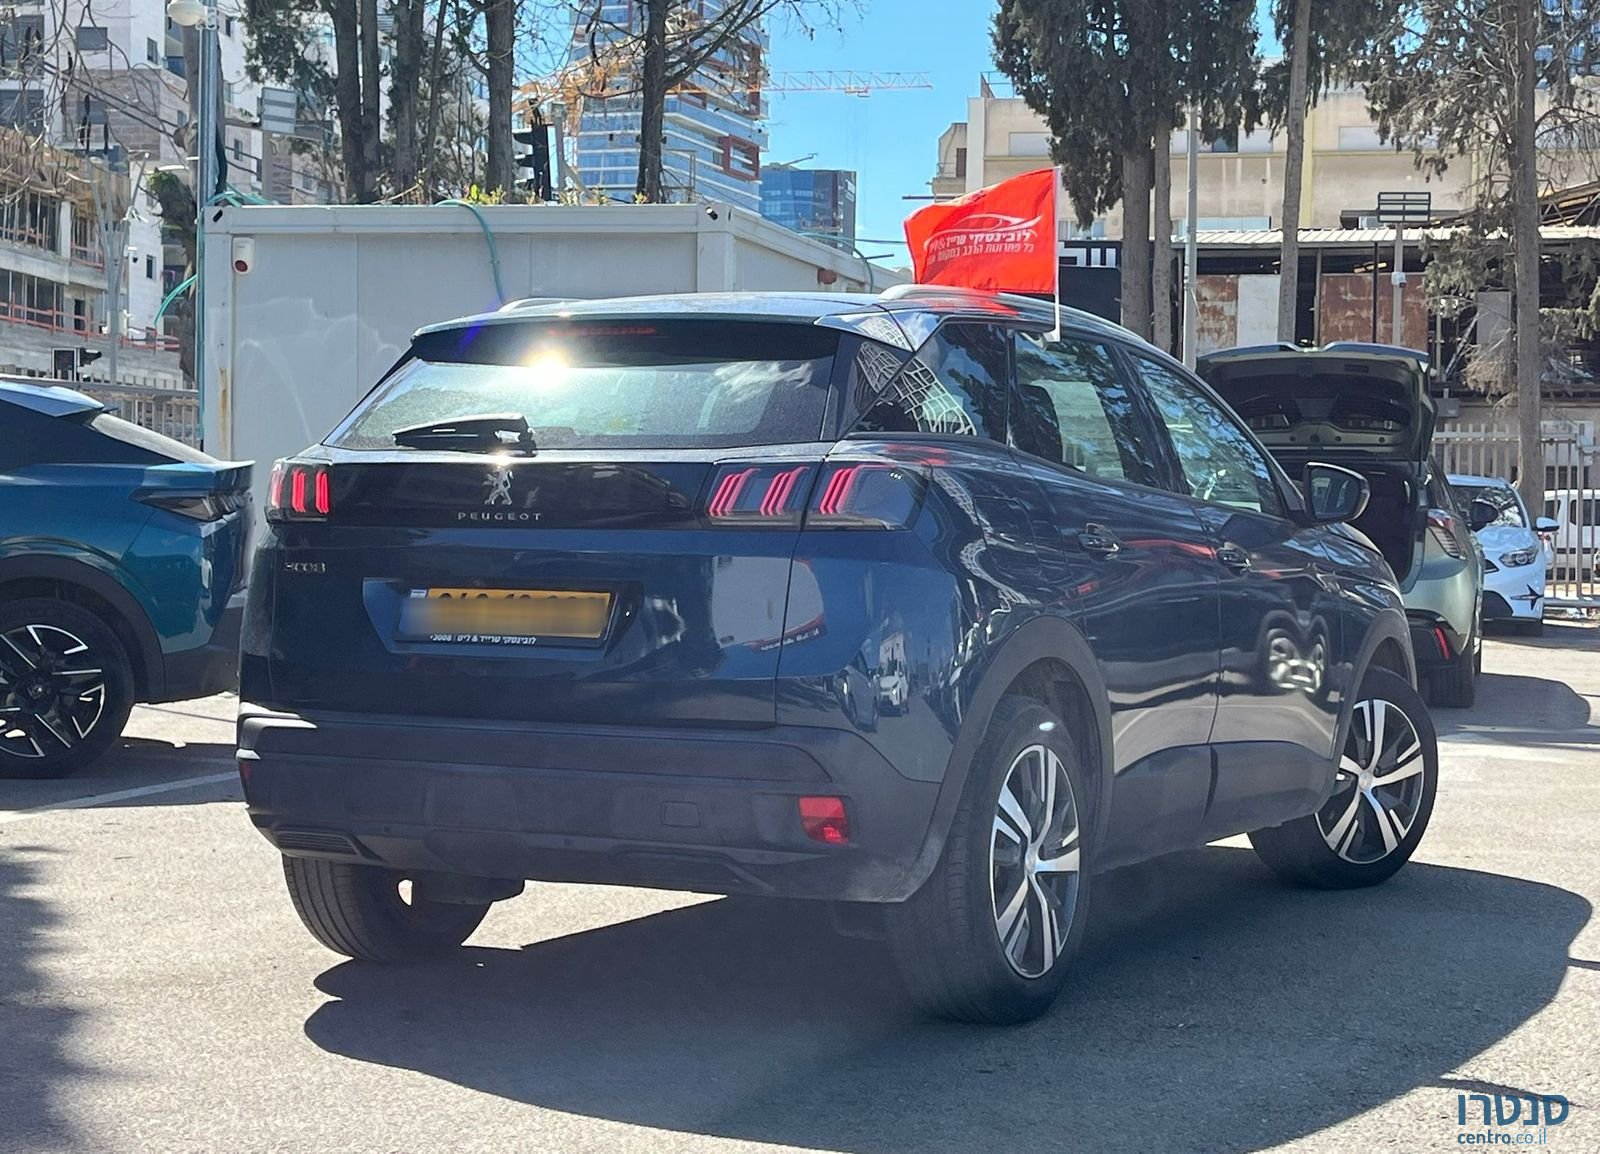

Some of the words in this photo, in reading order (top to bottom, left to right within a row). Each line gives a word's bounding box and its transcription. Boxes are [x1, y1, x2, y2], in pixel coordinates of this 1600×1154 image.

[969, 229, 1032, 245] לובינסקי
[1023, 243, 1034, 253] כל
[457, 511, 542, 522] PEUGEOT
